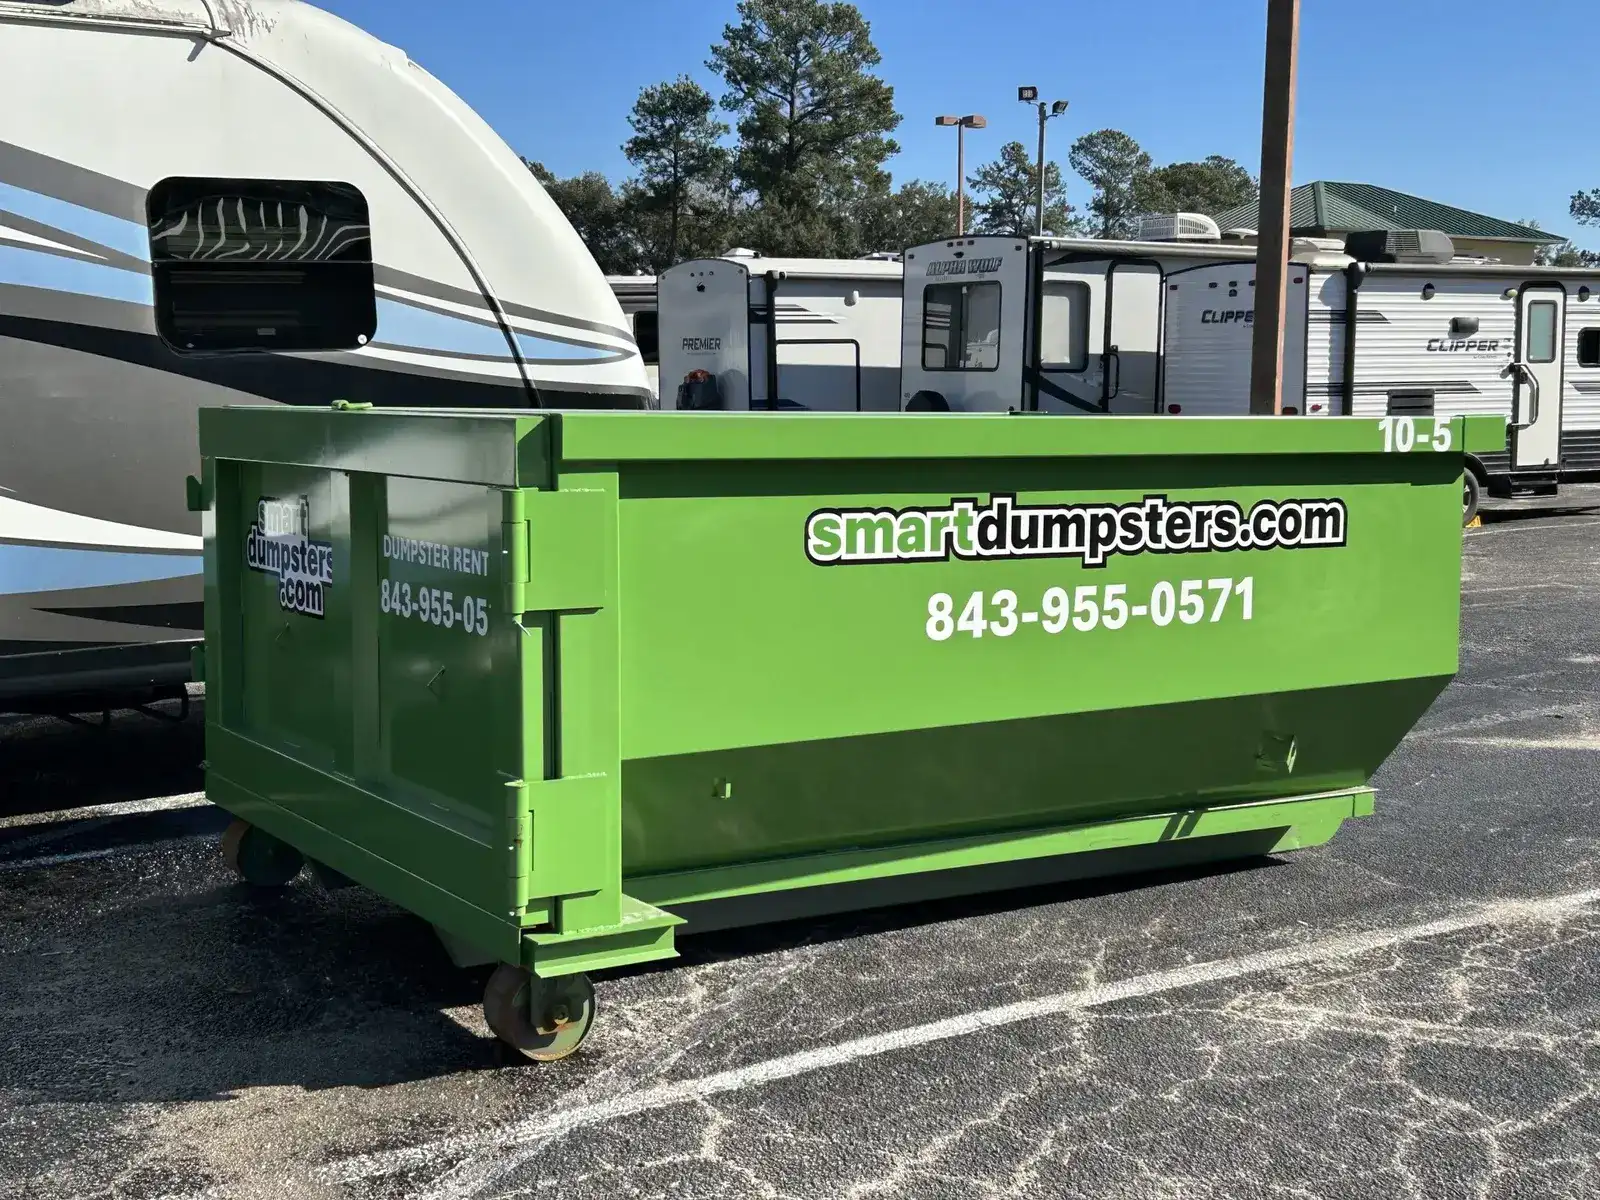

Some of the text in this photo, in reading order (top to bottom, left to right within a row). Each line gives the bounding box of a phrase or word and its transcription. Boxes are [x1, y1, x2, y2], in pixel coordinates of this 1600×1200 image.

[926, 260, 967, 276] ALPHA
[968, 257, 1003, 273] WOLF
[1201, 309, 1254, 323] CLIPPE
[682, 337, 721, 351] PREMIER
[1426, 338, 1499, 352] CLIPPER
[1378, 416, 1452, 453] 10-5
[257, 496, 309, 538] smart
[807, 496, 1346, 564] smartdumpsters.com
[383, 534, 489, 577] DUMPSTER RENT
[280, 577, 324, 615] .com
[381, 578, 489, 637] 843-955-05
[926, 576, 1254, 641] 843-955-0571
